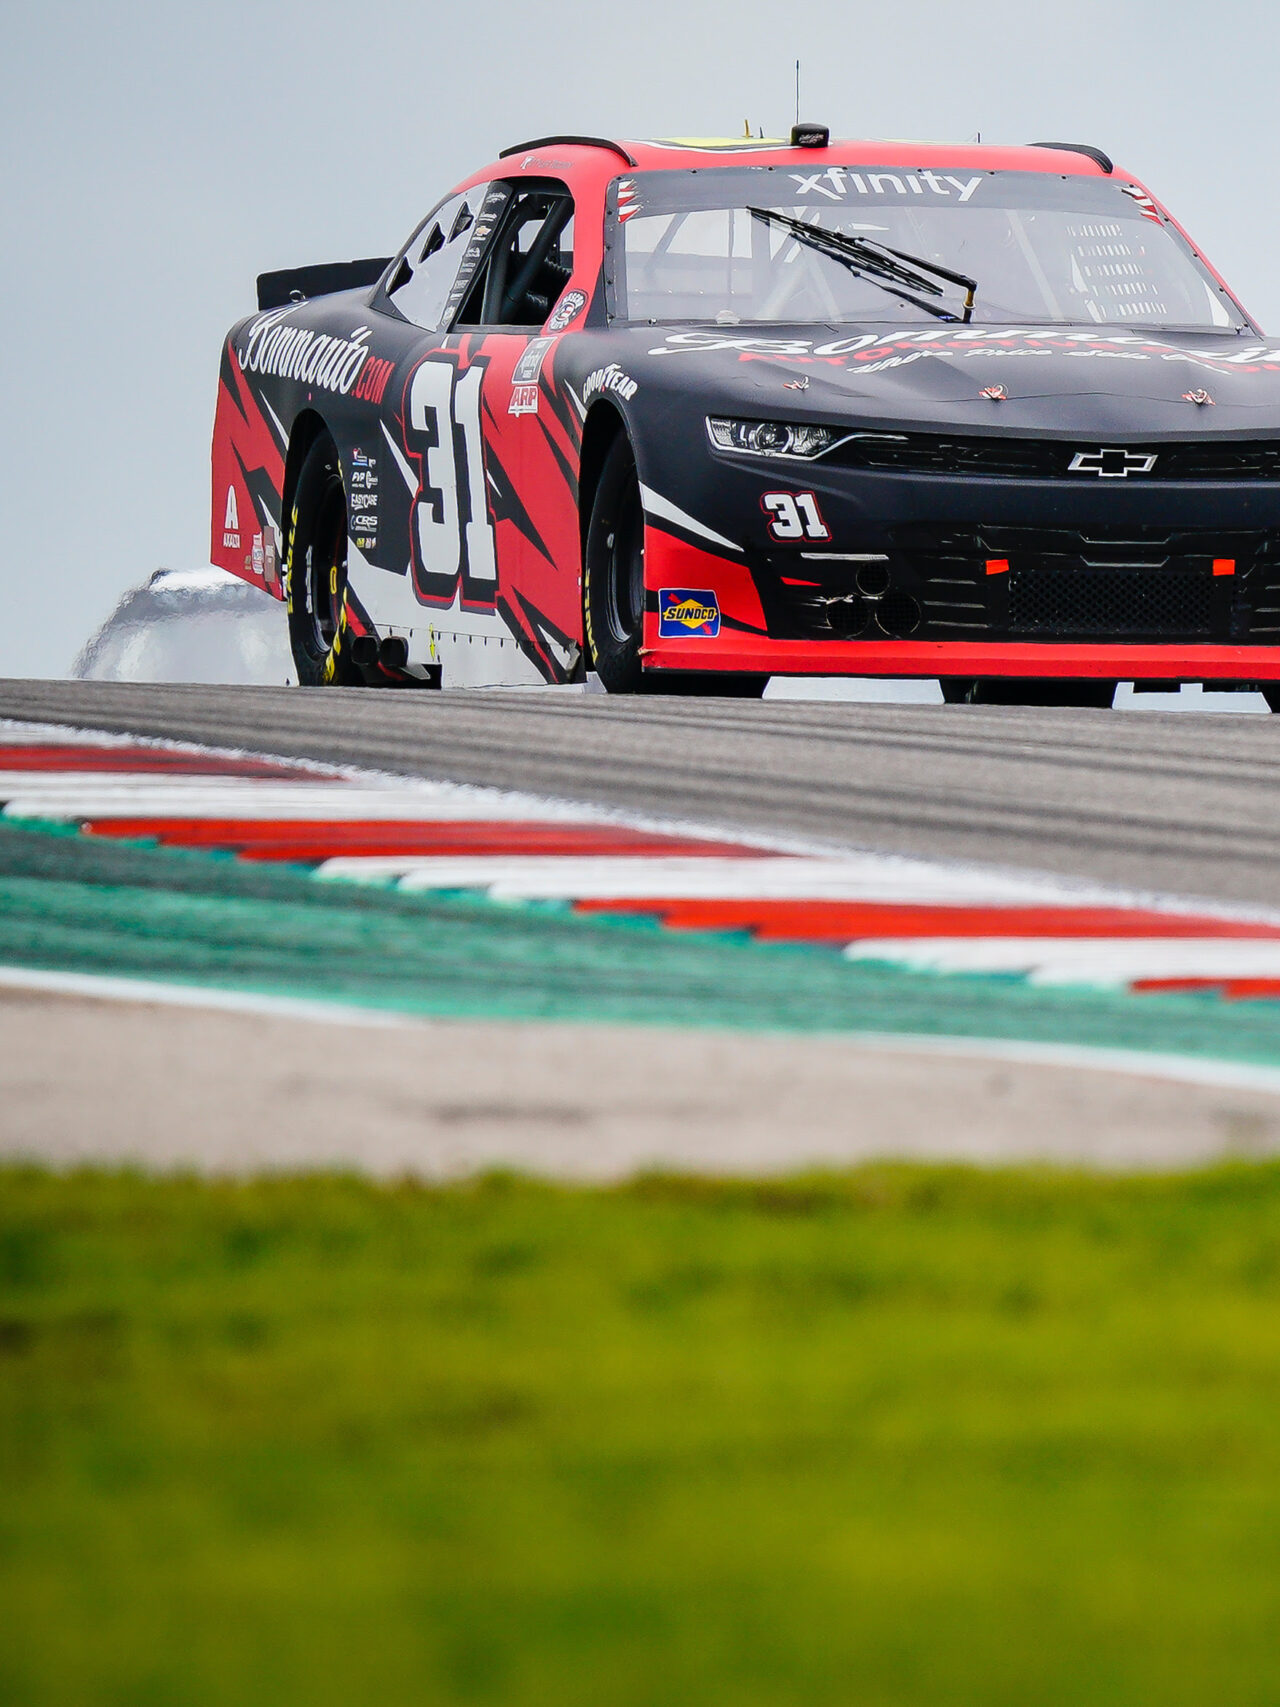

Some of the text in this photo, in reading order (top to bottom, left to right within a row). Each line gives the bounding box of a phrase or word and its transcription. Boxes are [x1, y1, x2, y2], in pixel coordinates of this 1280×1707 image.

[788, 167, 983, 202] xfinity
[582, 363, 638, 404] GOODYEAR
[410, 361, 497, 580] 31
[764, 493, 829, 537] 31
[665, 607, 716, 620] SUNOCO
